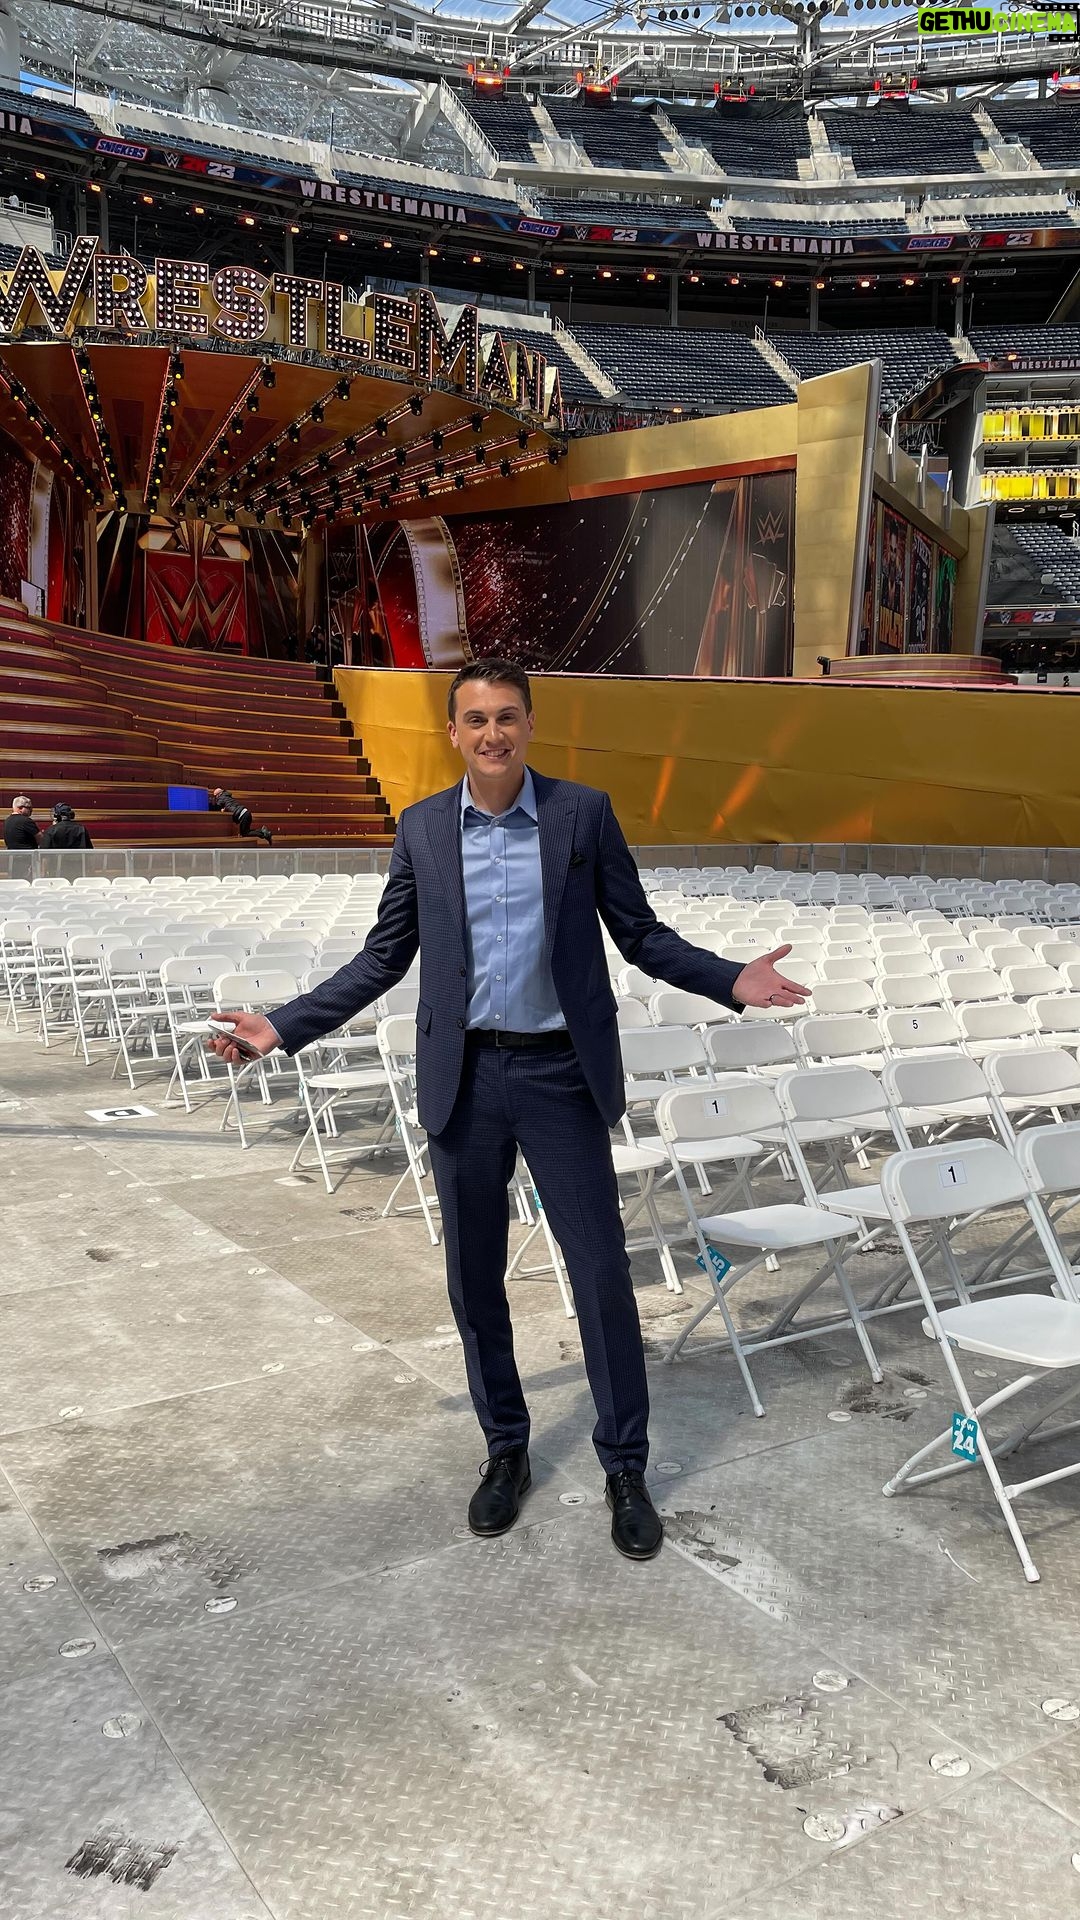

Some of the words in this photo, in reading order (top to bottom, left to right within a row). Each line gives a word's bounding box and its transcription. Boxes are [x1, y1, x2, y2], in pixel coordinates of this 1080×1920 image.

[99, 140, 146, 159] SNICKERS
[300, 179, 468, 224] WRESTLEMANIA
[519, 221, 559, 237] SNICKERS
[697, 232, 855, 254] WRESTLEMANIA
[909, 237, 951, 249] SNICKERS
[956, 954, 965, 963] 10
[912, 1019, 919, 1030] 5
[711, 1100, 719, 1114] 1
[948, 1165, 957, 1183] 1
[953, 1430, 975, 1455] 24
